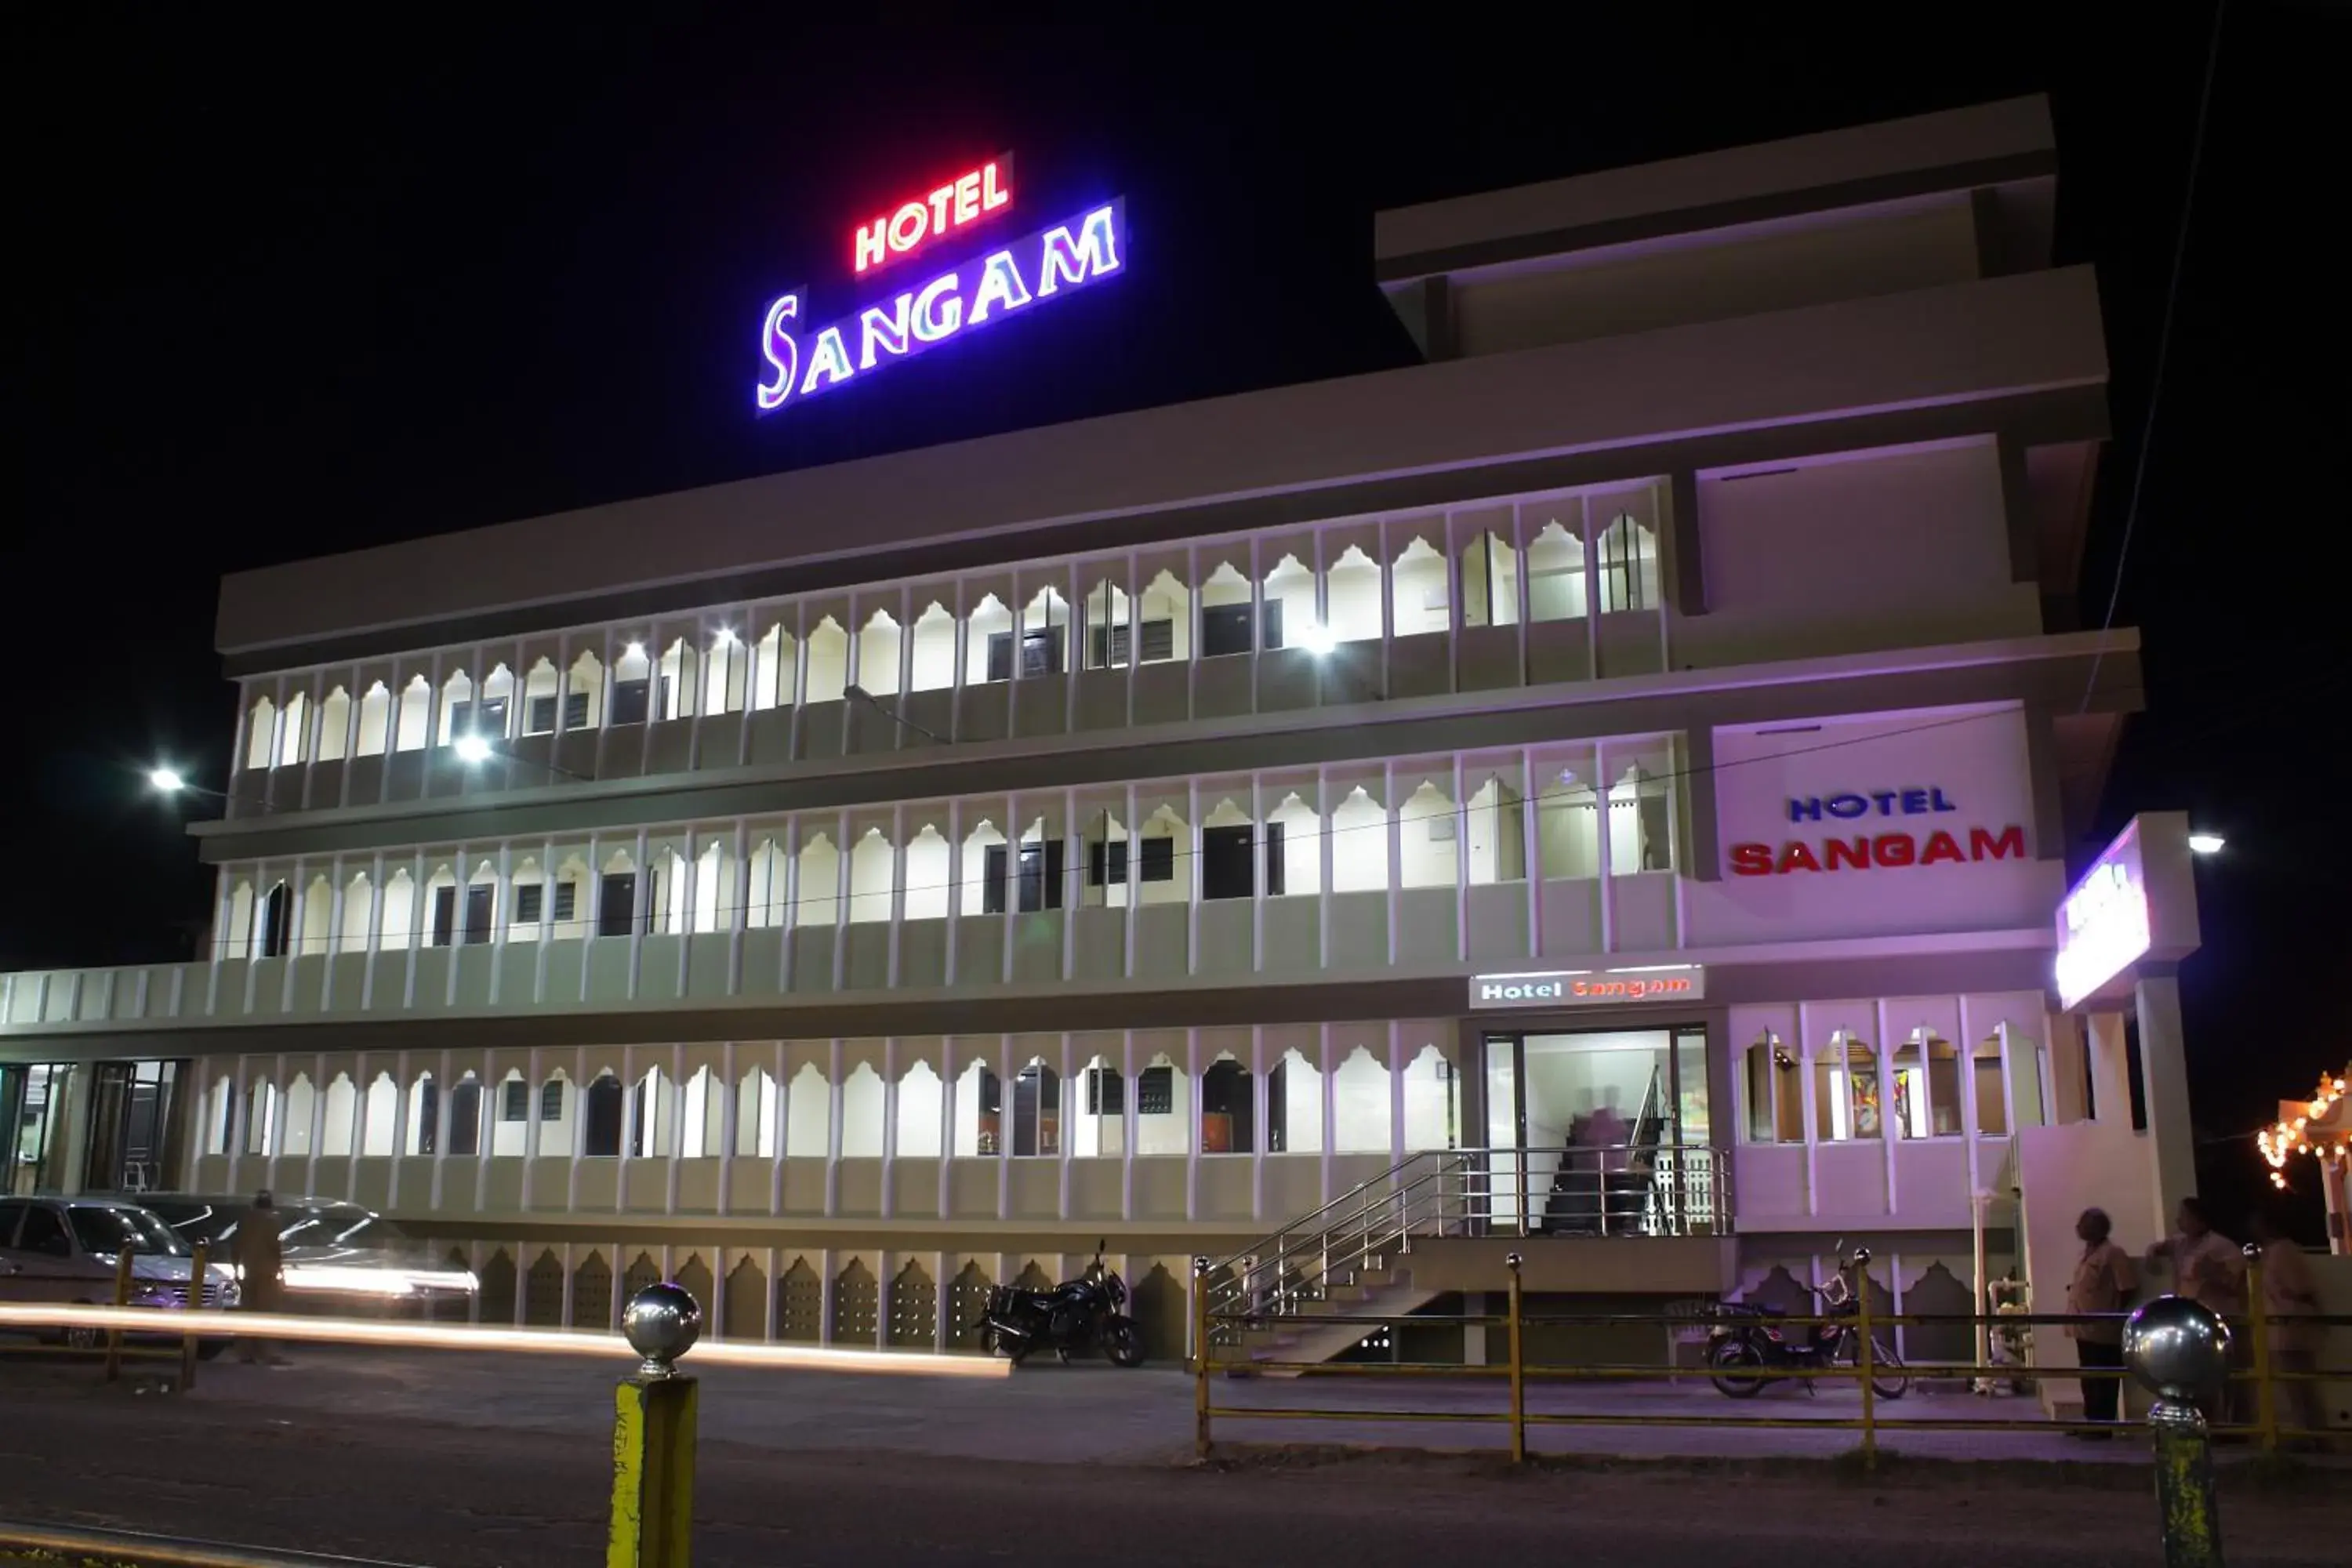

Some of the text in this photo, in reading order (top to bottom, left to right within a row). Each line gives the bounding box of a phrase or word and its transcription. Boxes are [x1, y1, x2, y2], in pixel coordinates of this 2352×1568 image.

[855, 163, 1008, 272] HOTEL
[758, 205, 1120, 408] SANGAM
[1788, 787, 1956, 822] HOTEL
[1730, 826, 2026, 877] SANGAM
[1482, 978, 1691, 1000] Hotel Sangam
